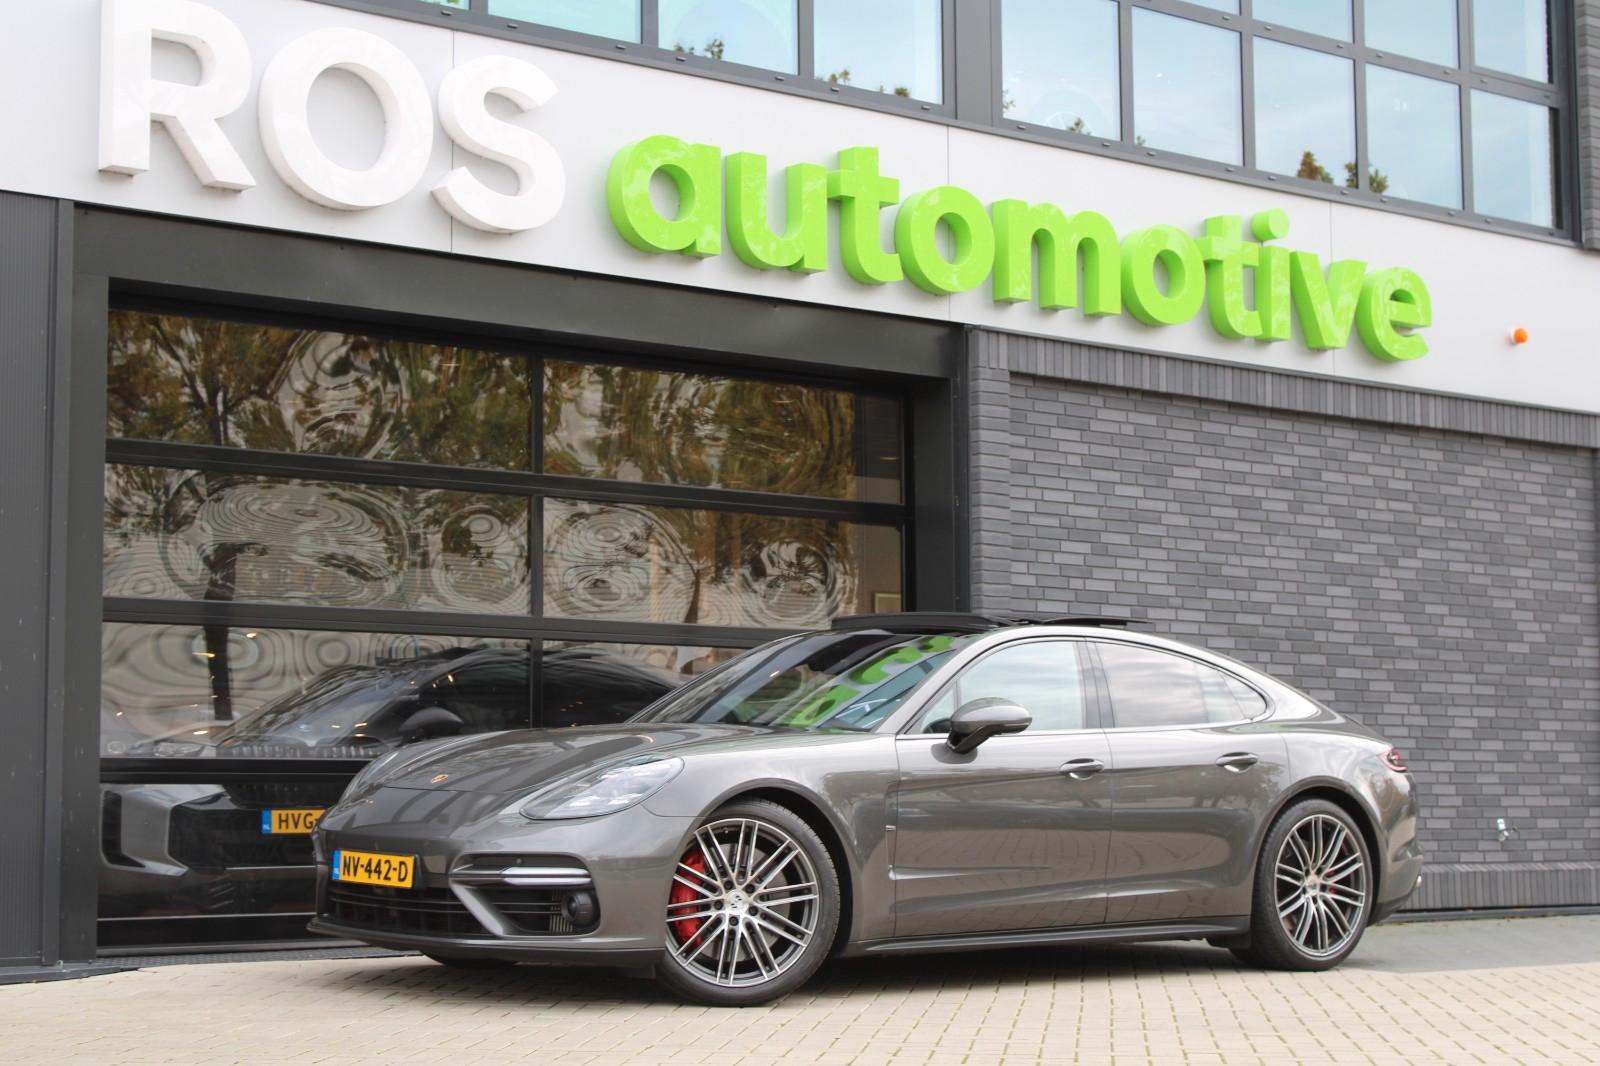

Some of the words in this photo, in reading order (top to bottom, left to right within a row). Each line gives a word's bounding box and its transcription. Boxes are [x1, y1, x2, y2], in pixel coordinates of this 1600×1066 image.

[98, 0, 566, 235] ROS
[606, 135, 1433, 361] automotive
[342, 855, 408, 882] NV-442-D
